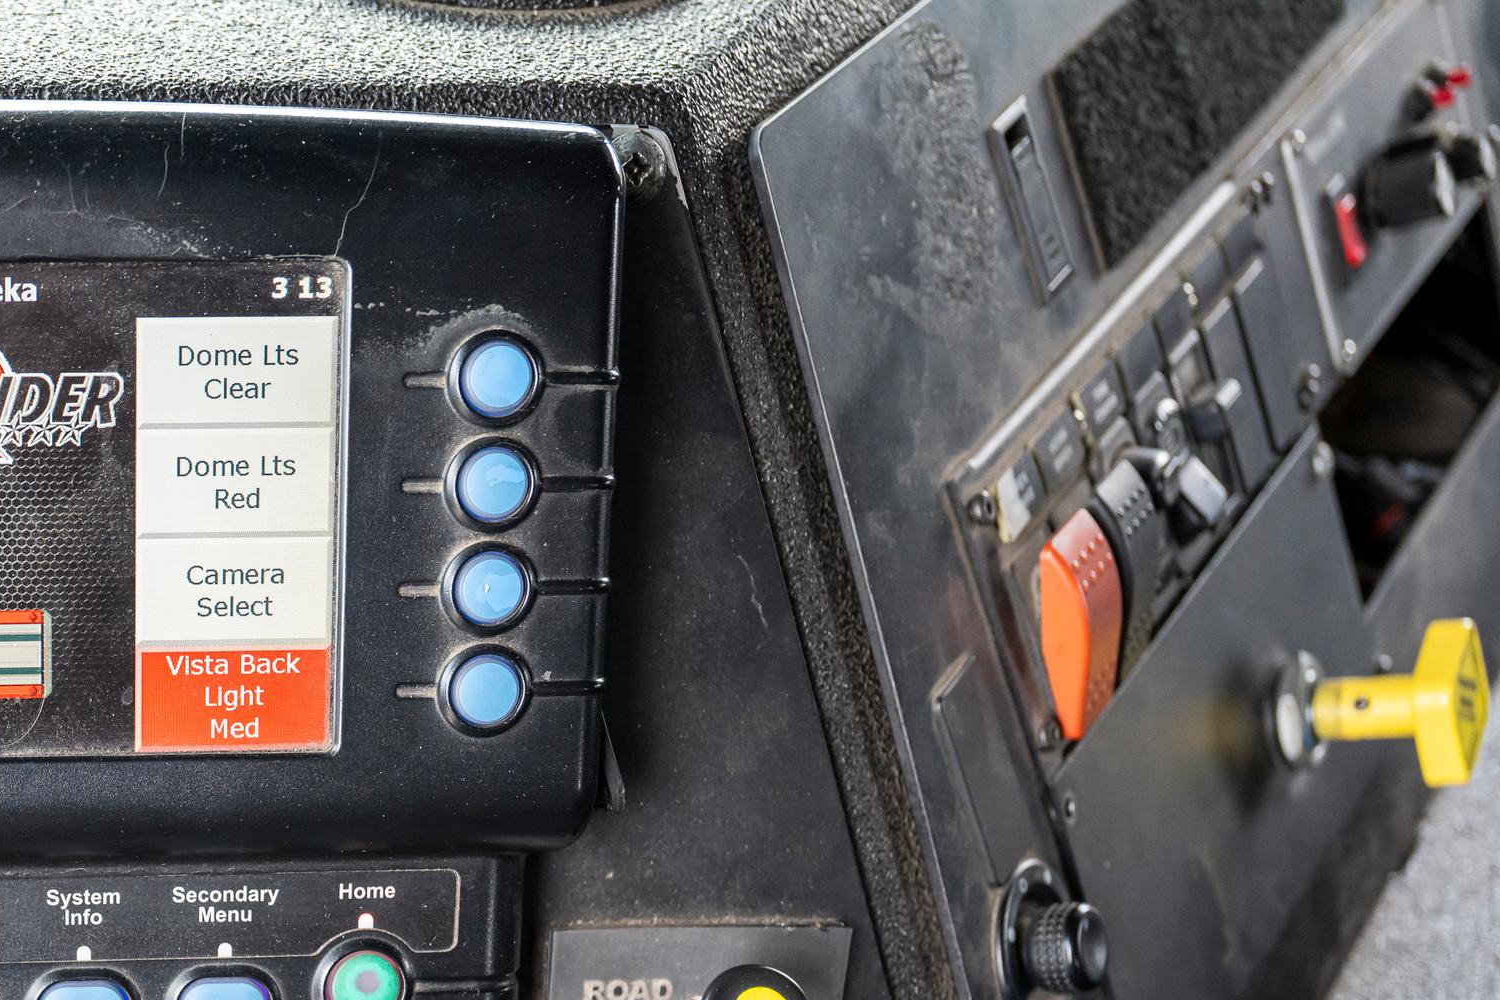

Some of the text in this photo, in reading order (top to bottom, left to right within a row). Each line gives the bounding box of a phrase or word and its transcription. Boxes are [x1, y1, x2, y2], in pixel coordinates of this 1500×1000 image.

[177, 344, 300, 367] Dome Lts
[204, 377, 272, 401] Clear
[175, 456, 297, 478] Dome Lts
[214, 488, 261, 510] Red
[186, 565, 286, 587] Camera
[196, 595, 274, 618] Select
[166, 653, 301, 676] Vista Back
[204, 686, 265, 712] Light
[210, 717, 260, 739] Med
[45, 889, 121, 911] System
[171, 885, 280, 906] Secondary
[338, 882, 397, 901] Home
[64, 907, 103, 926] Info
[198, 905, 253, 924] Menu
